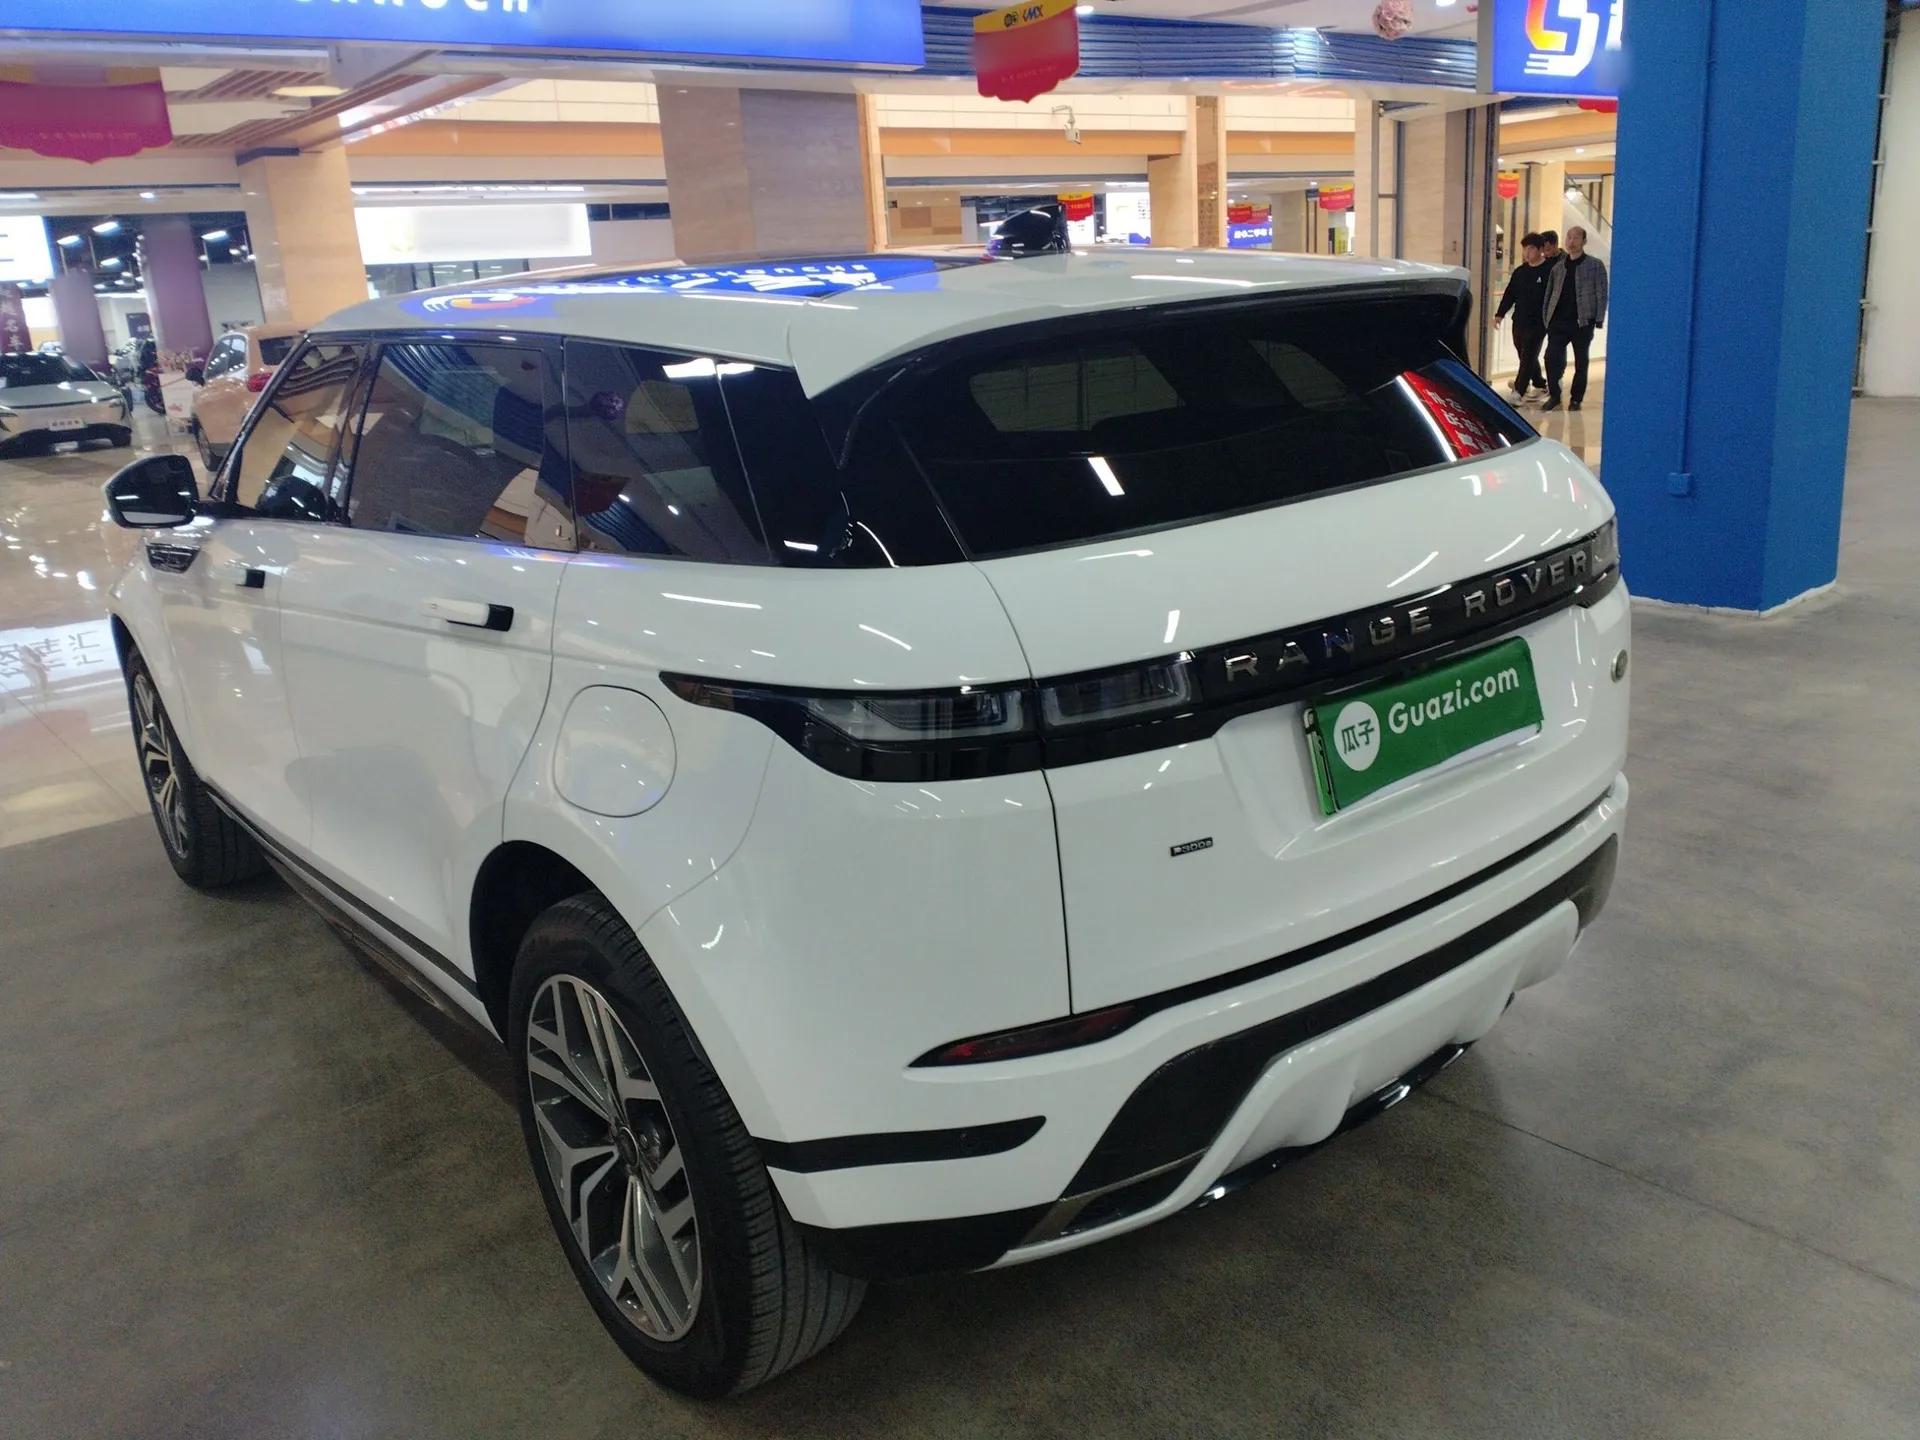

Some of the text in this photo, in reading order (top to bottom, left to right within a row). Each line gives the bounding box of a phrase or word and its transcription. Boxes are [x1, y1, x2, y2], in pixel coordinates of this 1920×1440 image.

[1224, 550, 1588, 682] RANGE ROVER
[1340, 667, 1520, 755] 瓜子 Guazi.com
